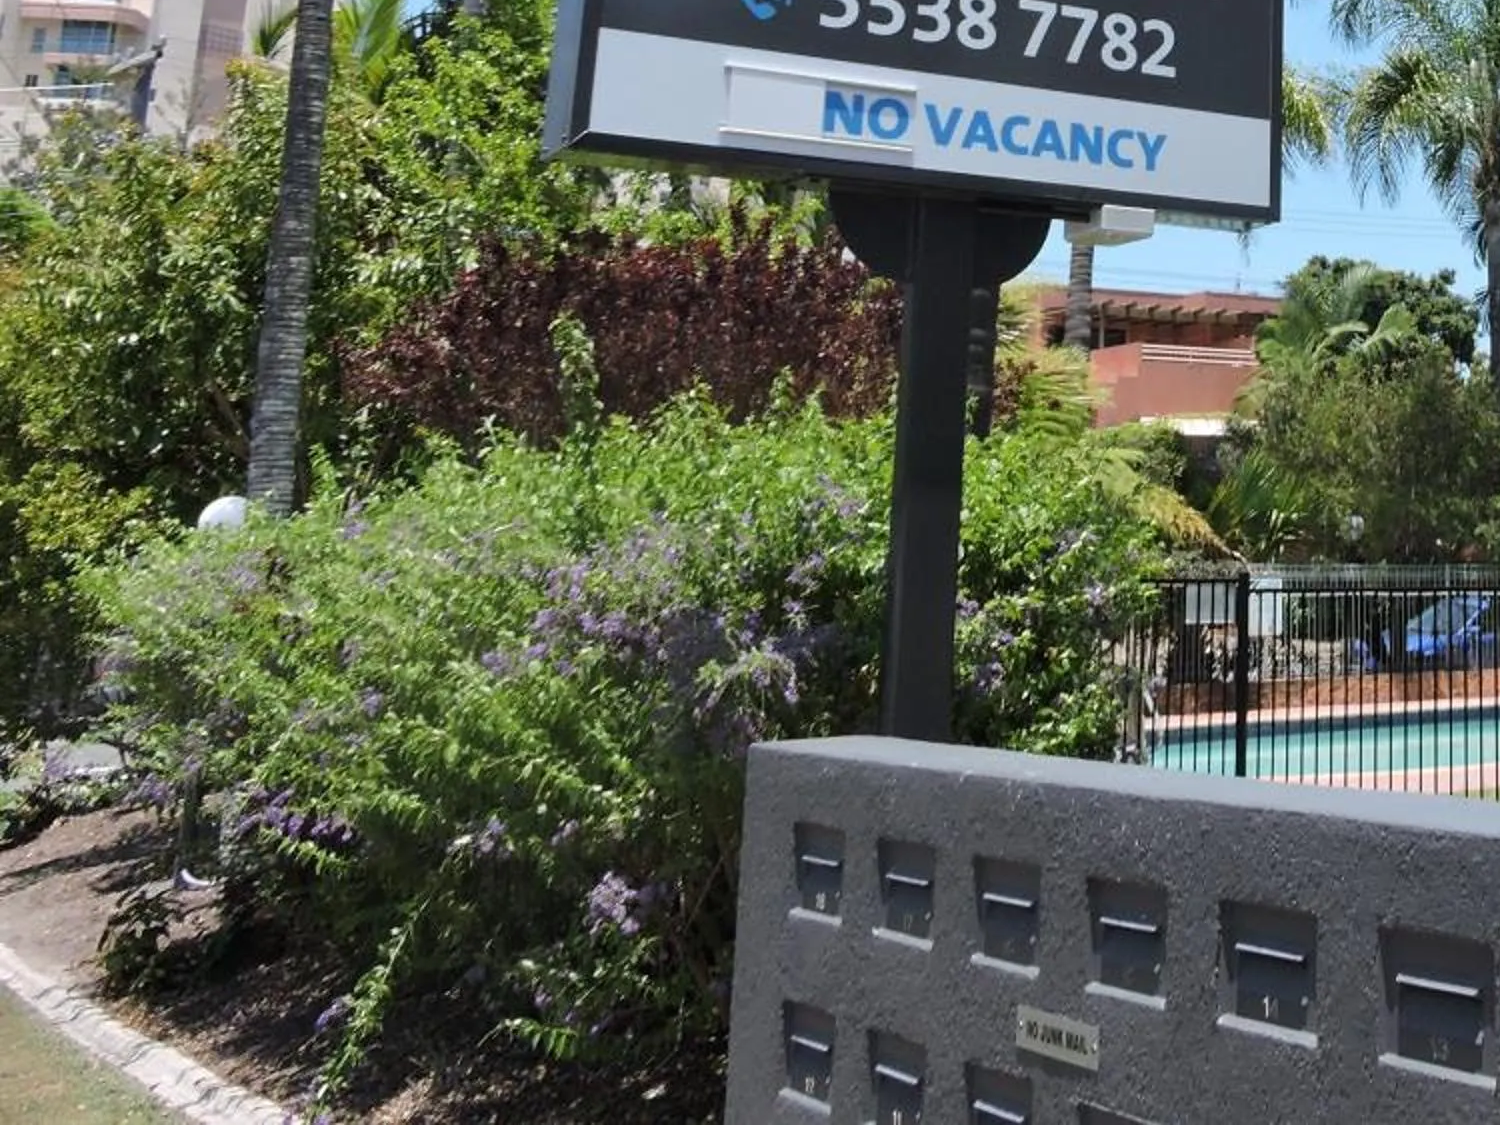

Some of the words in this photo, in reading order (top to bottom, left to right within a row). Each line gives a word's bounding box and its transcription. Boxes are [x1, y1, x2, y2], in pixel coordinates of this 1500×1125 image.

[822, 89, 910, 140] NO
[924, 103, 1167, 172] VACANCY
[1025, 1020, 1039, 1040] NO
[1041, 1024, 1063, 1048] JUNK
[1065, 1030, 1088, 1056] MAIL
